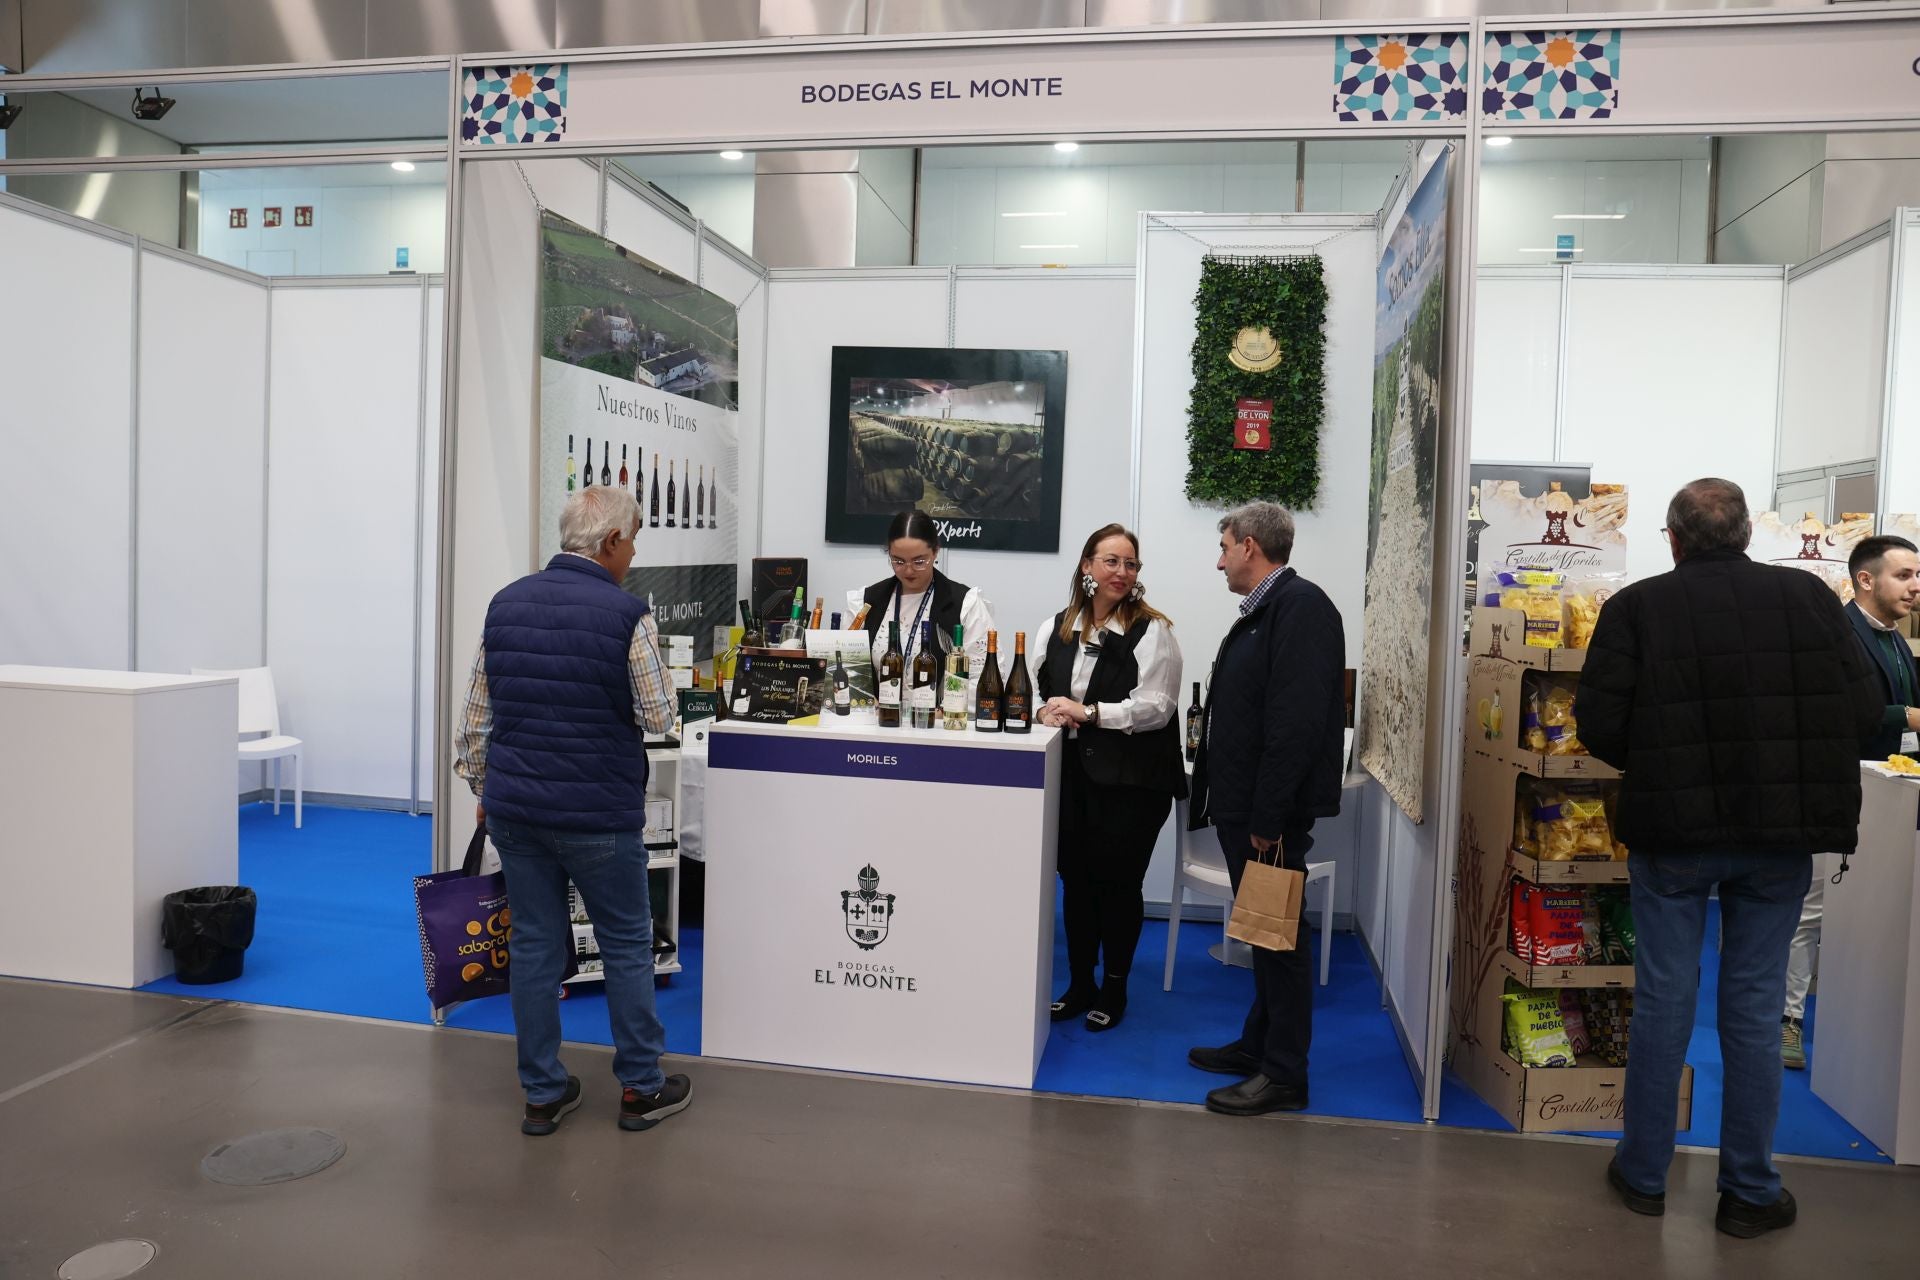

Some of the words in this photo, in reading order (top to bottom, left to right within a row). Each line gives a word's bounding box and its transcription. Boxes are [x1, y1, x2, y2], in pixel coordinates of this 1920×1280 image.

[801, 81, 922, 104] BODEGAS
[930, 80, 961, 100] EL
[969, 77, 1063, 99] MONTE
[597, 384, 660, 425] Nuestros
[664, 401, 698, 433] Vinos
[1237, 411, 1249, 419] DE
[1249, 411, 1269, 420] LYON
[1506, 549, 1549, 567] Castillo
[1549, 550, 1561, 561] de
[1556, 551, 1602, 570] Moriles
[658, 604, 670, 622] EL
[672, 601, 703, 621] MONTE
[847, 753, 898, 766] MORILES
[837, 961, 896, 974] BODEGAS
[814, 969, 836, 985] EL
[843, 971, 918, 993] MONTE
[1528, 1001, 1557, 1012] PAPAS
[1539, 1094, 1600, 1120] Castillo
[1600, 1093, 1616, 1108] de
